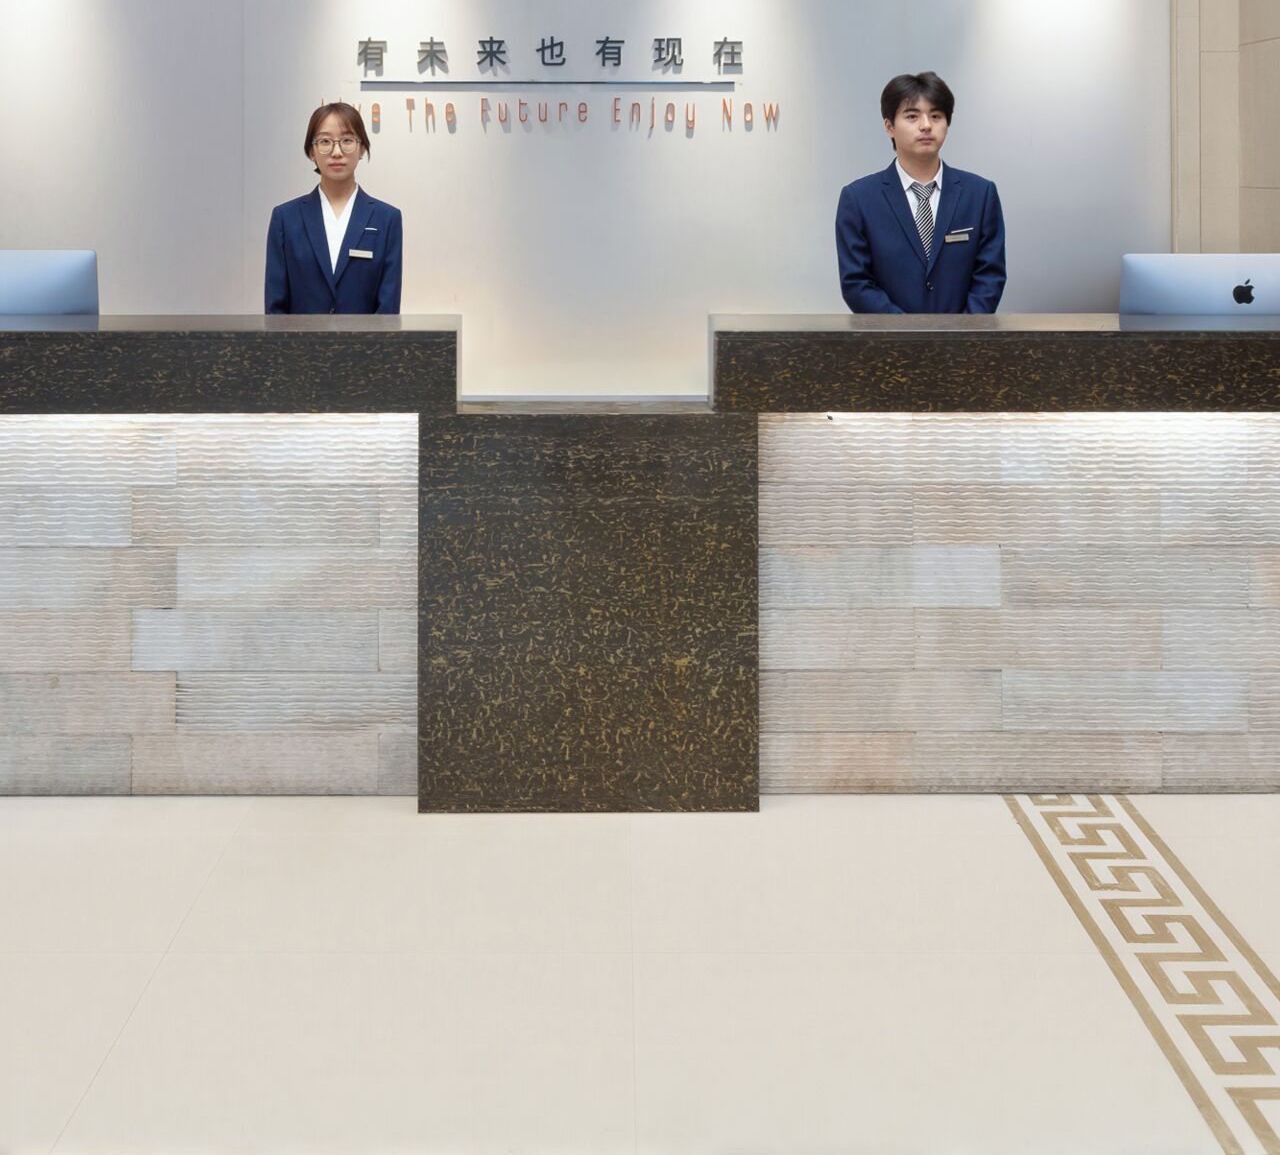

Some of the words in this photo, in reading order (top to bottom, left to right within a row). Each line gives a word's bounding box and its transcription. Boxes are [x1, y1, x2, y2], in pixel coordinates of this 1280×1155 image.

[357, 35, 743, 68] 有未来也有现在
[405, 96, 456, 124] The
[480, 97, 589, 124] Future
[613, 96, 696, 130] Enjoy
[722, 97, 780, 125] Now
